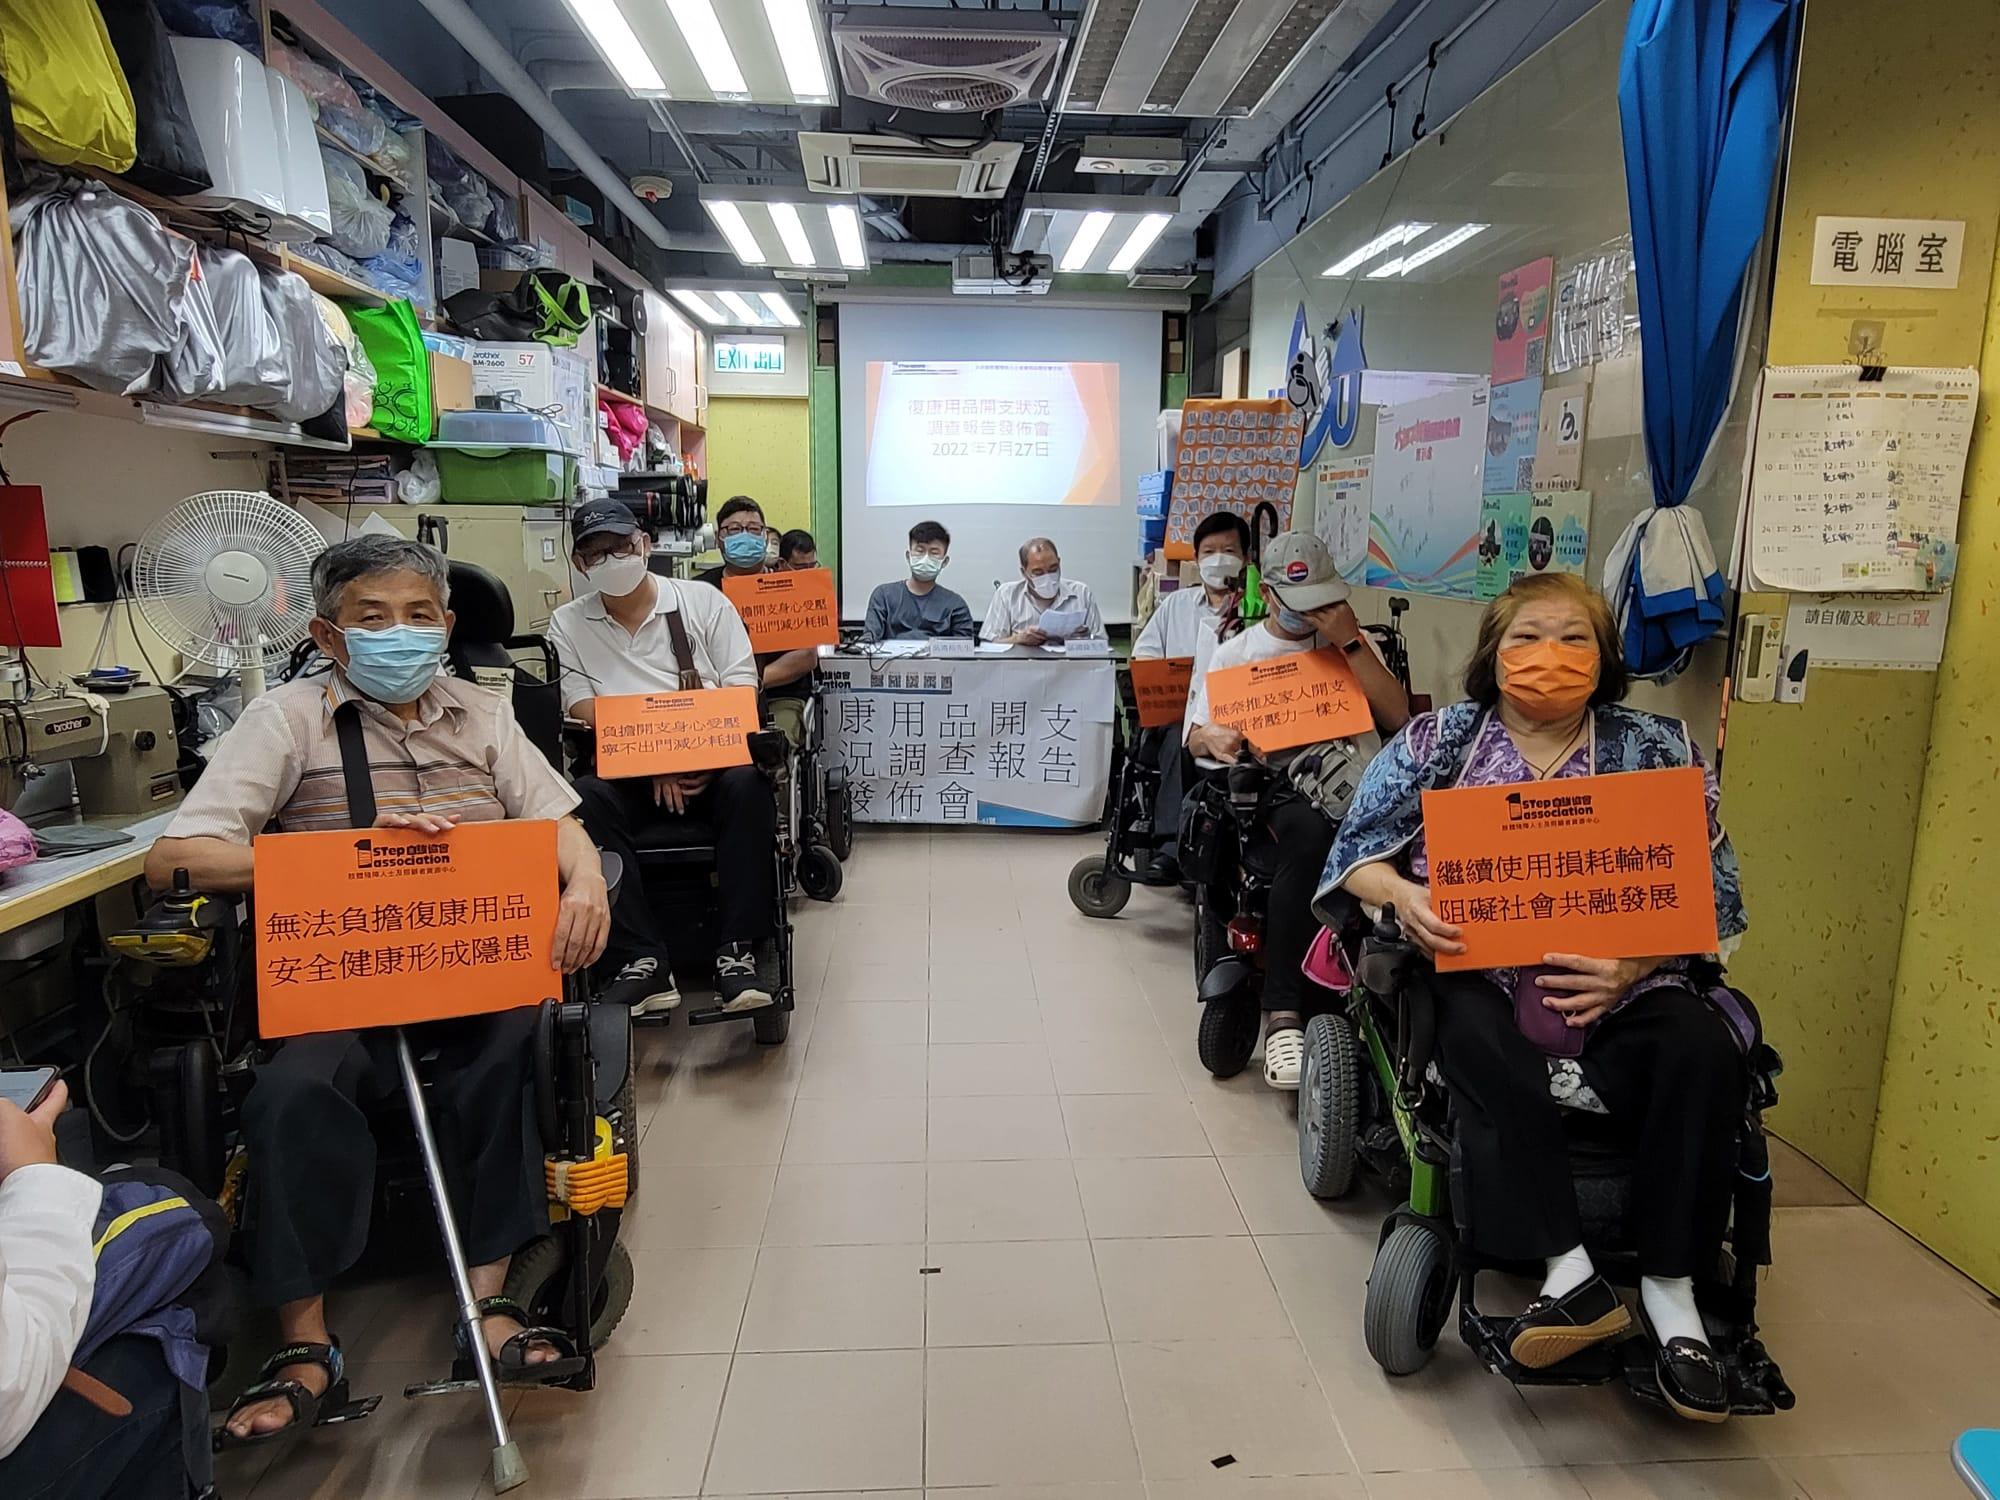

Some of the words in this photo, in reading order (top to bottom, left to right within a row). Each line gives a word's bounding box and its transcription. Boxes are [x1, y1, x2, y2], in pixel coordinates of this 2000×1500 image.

[1832, 230, 1948, 275] 電腦室
[518, 354, 535, 365] 57
[754, 351, 782, 370] 出口
[908, 399, 1050, 416] 復康用品開支狀況
[927, 420, 1049, 438] 調查報告發佈會
[1805, 608, 1930, 628] 請自備及戴上口罩
[1213, 679, 1346, 720] 無奈推及家人開支
[53, 720, 82, 733] brother
[1225, 699, 1350, 734] 顧者壓力一樣大
[602, 717, 741, 739] 負擔開支身心受壓
[602, 732, 742, 757] 寧不出門減少耗損
[1523, 806, 1594, 820] association
[373, 854, 450, 868] association
[1435, 842, 1676, 887] 繼續使用損耗輪椅
[1439, 883, 1681, 925] 阻礙社會共融發展
[266, 893, 531, 944] 無法負擔復康用品
[266, 934, 533, 988] 安全健康形成隱患
